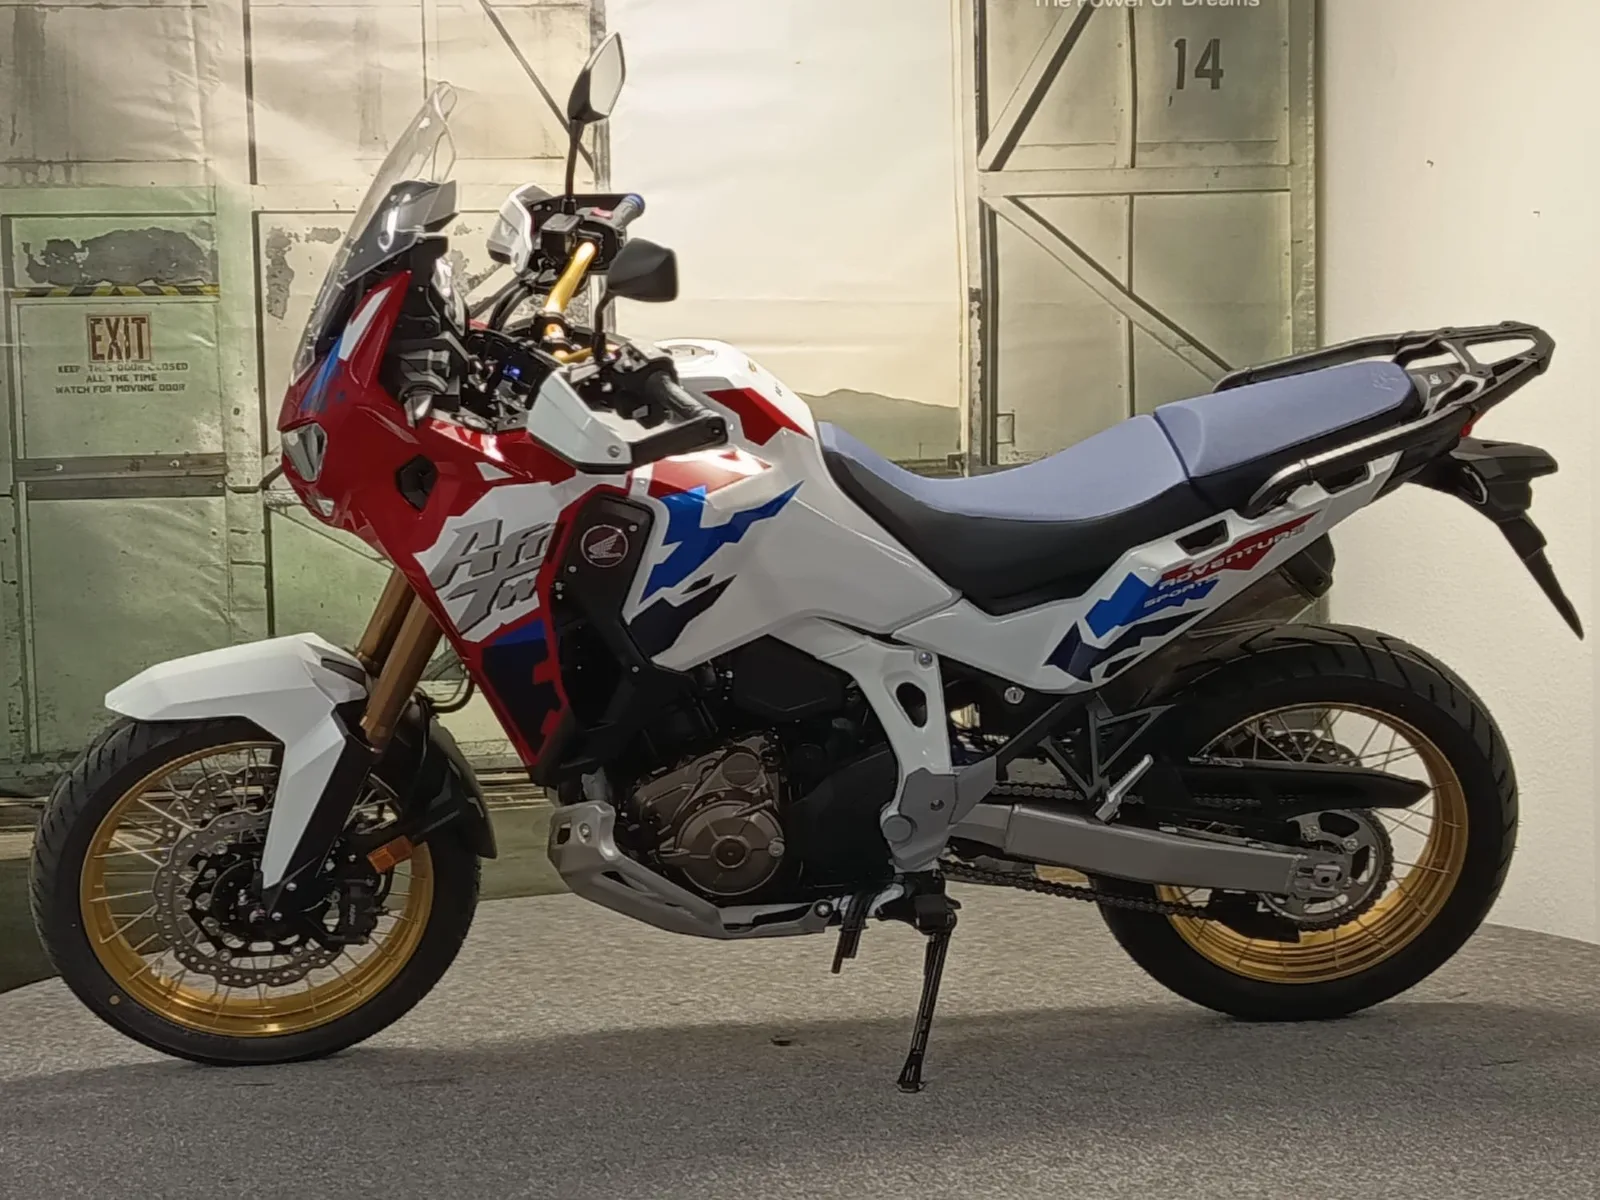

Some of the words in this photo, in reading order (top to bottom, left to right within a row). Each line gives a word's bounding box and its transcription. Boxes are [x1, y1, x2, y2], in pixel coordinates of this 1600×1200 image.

[1077, 0, 1143, 8] ower
[1173, 38, 1224, 90] 14
[90, 317, 147, 360] EXIT
[88, 364, 112, 373] THS
[86, 374, 105, 383] ALL
[110, 374, 129, 382] THE
[133, 373, 158, 382] TIME
[55, 385, 90, 394] WATCH
[93, 385, 112, 394] FOR
[116, 383, 154, 393] MOVING
[158, 383, 186, 392] DOOR
